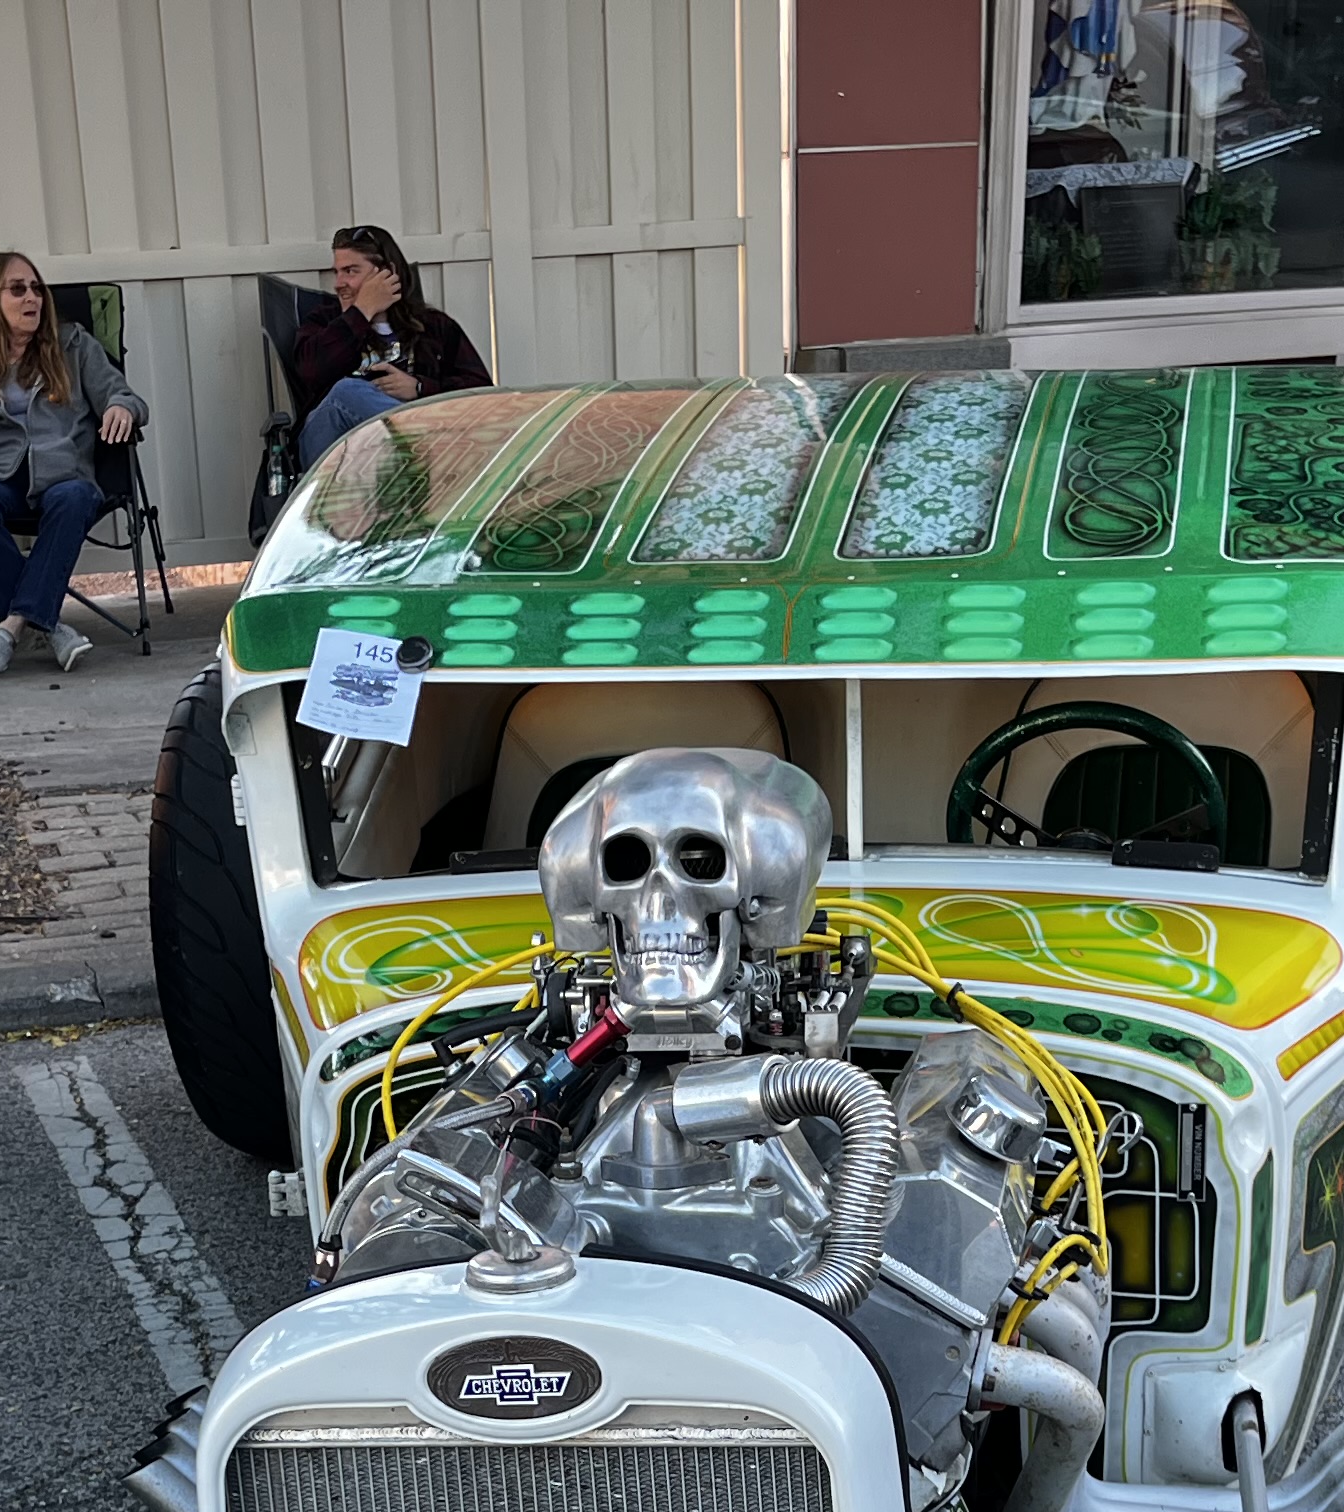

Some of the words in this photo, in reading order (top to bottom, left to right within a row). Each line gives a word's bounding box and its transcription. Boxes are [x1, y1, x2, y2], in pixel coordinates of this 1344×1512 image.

[354, 642, 394, 663] 145
[1194, 1124, 1203, 1140] VIN
[1194, 1142, 1202, 1180] NUMBER
[471, 1377, 559, 1394] CHEVROLET
